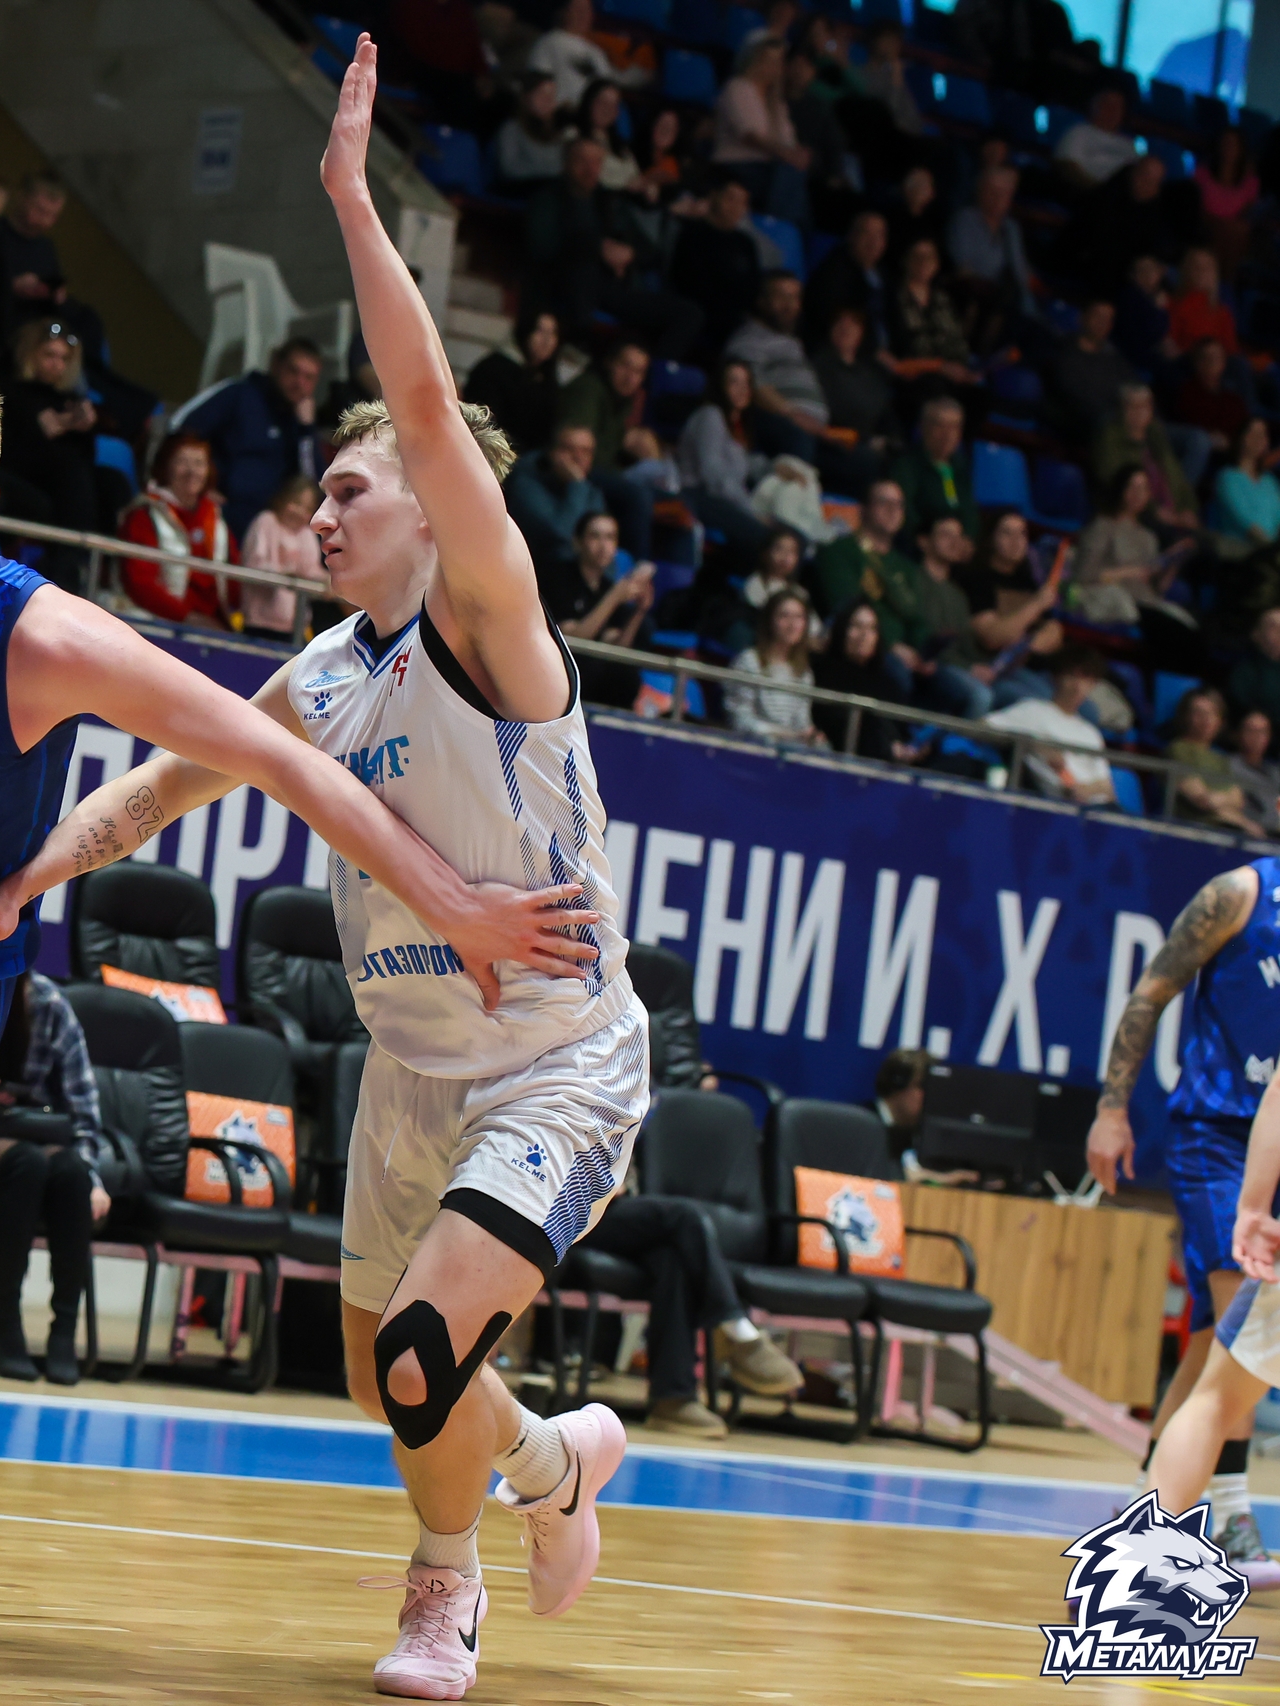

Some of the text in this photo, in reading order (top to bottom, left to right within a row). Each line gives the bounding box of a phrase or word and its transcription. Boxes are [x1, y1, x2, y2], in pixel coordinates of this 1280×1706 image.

[303, 711, 331, 720] KELME
[858, 868, 951, 1059] И.
[976, 889, 1070, 1077] Х.
[510, 1157, 547, 1182] KELME
